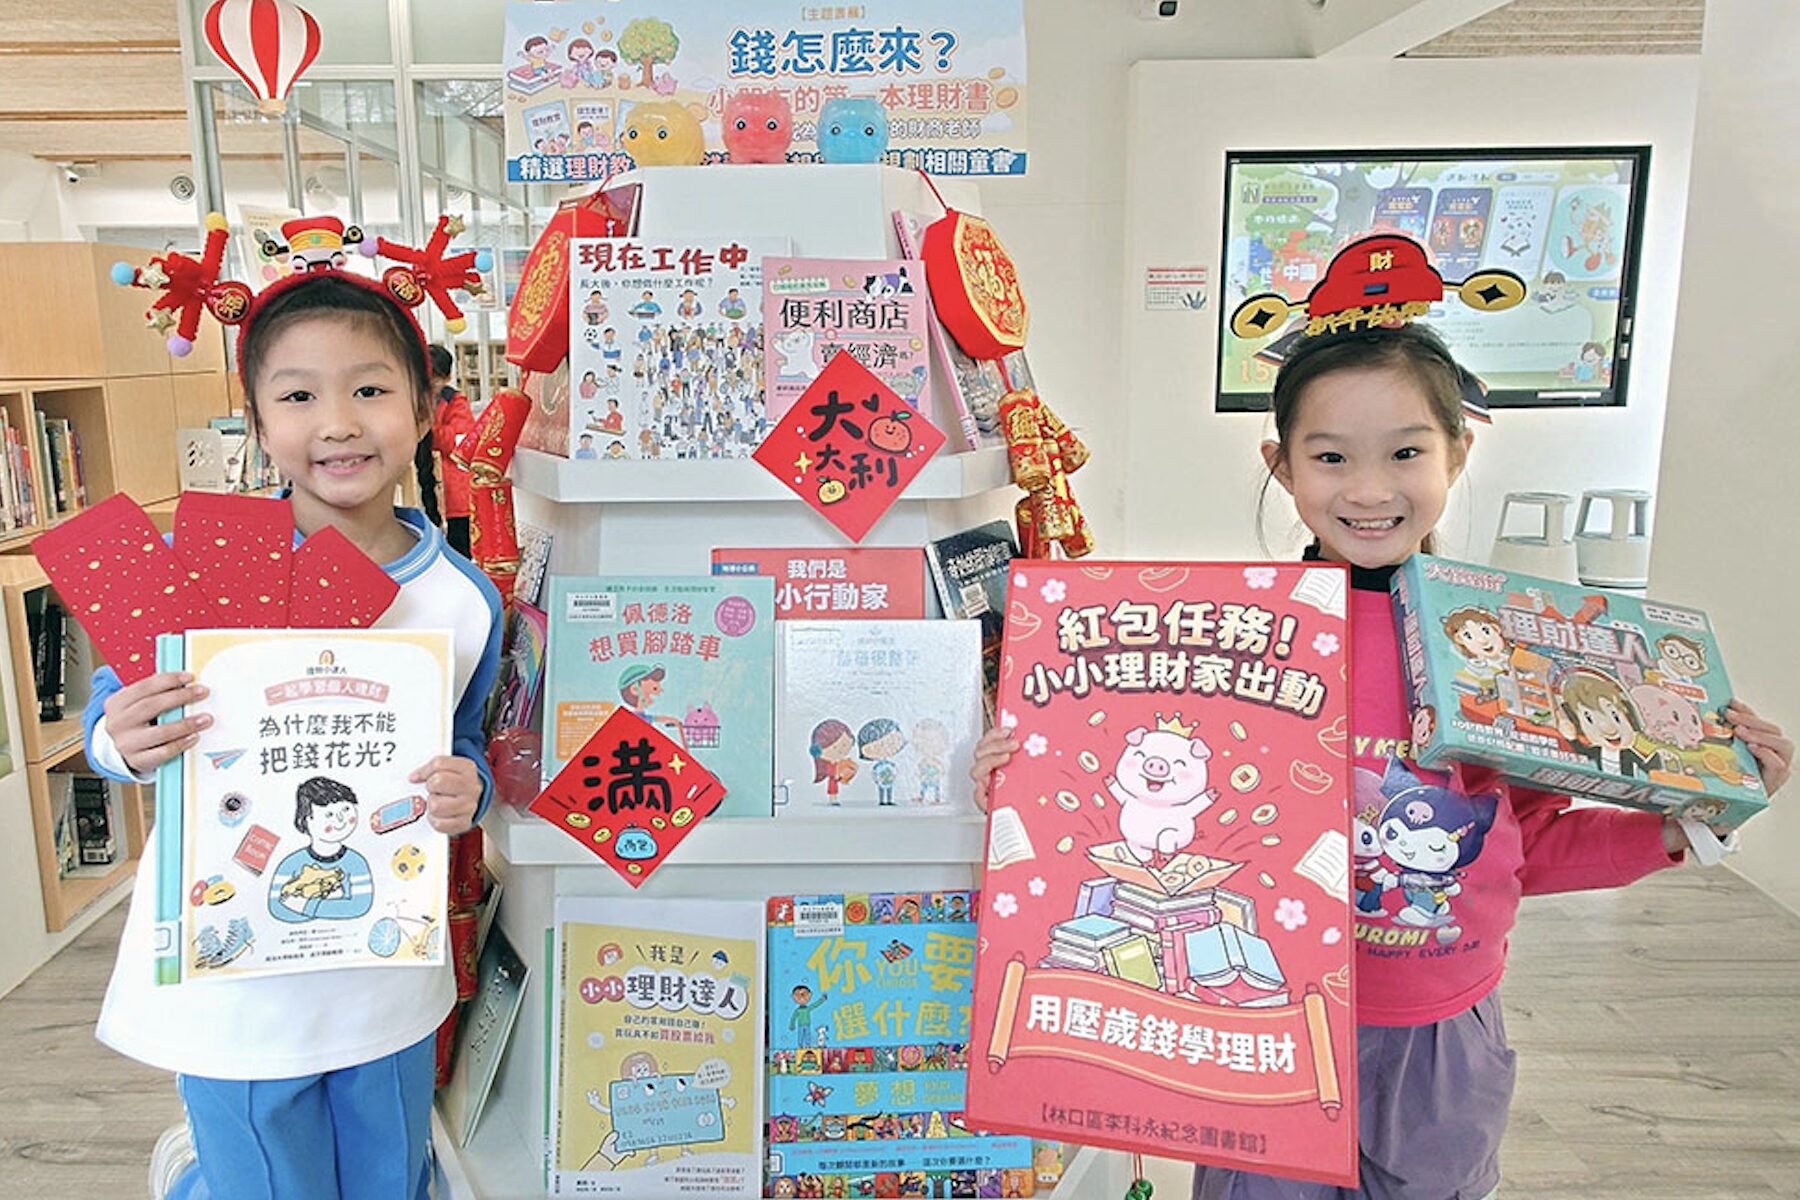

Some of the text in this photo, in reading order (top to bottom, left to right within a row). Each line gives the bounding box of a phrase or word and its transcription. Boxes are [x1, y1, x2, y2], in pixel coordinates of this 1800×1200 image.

[578, 242, 749, 276] 現在工作中
[1369, 248, 1395, 273] 財
[779, 297, 910, 330] 便利商店
[808, 390, 865, 443] 大
[787, 558, 849, 580] 我們是
[775, 582, 890, 612] 小行動家
[588, 628, 722, 662] 想買腳踏車
[1057, 600, 1299, 660] 紅包任務!
[1023, 652, 1328, 718] 小小理財家出動
[259, 711, 396, 738] 為什麼我不能
[582, 737, 672, 815] 滿
[649, 944, 685, 966] 我是
[806, 935, 873, 994] 你
[1418, 946, 1457, 959] EVERY
[581, 973, 740, 1012] 小小理財達人
[1027, 993, 1297, 1076] 用壓歲錢學理財
